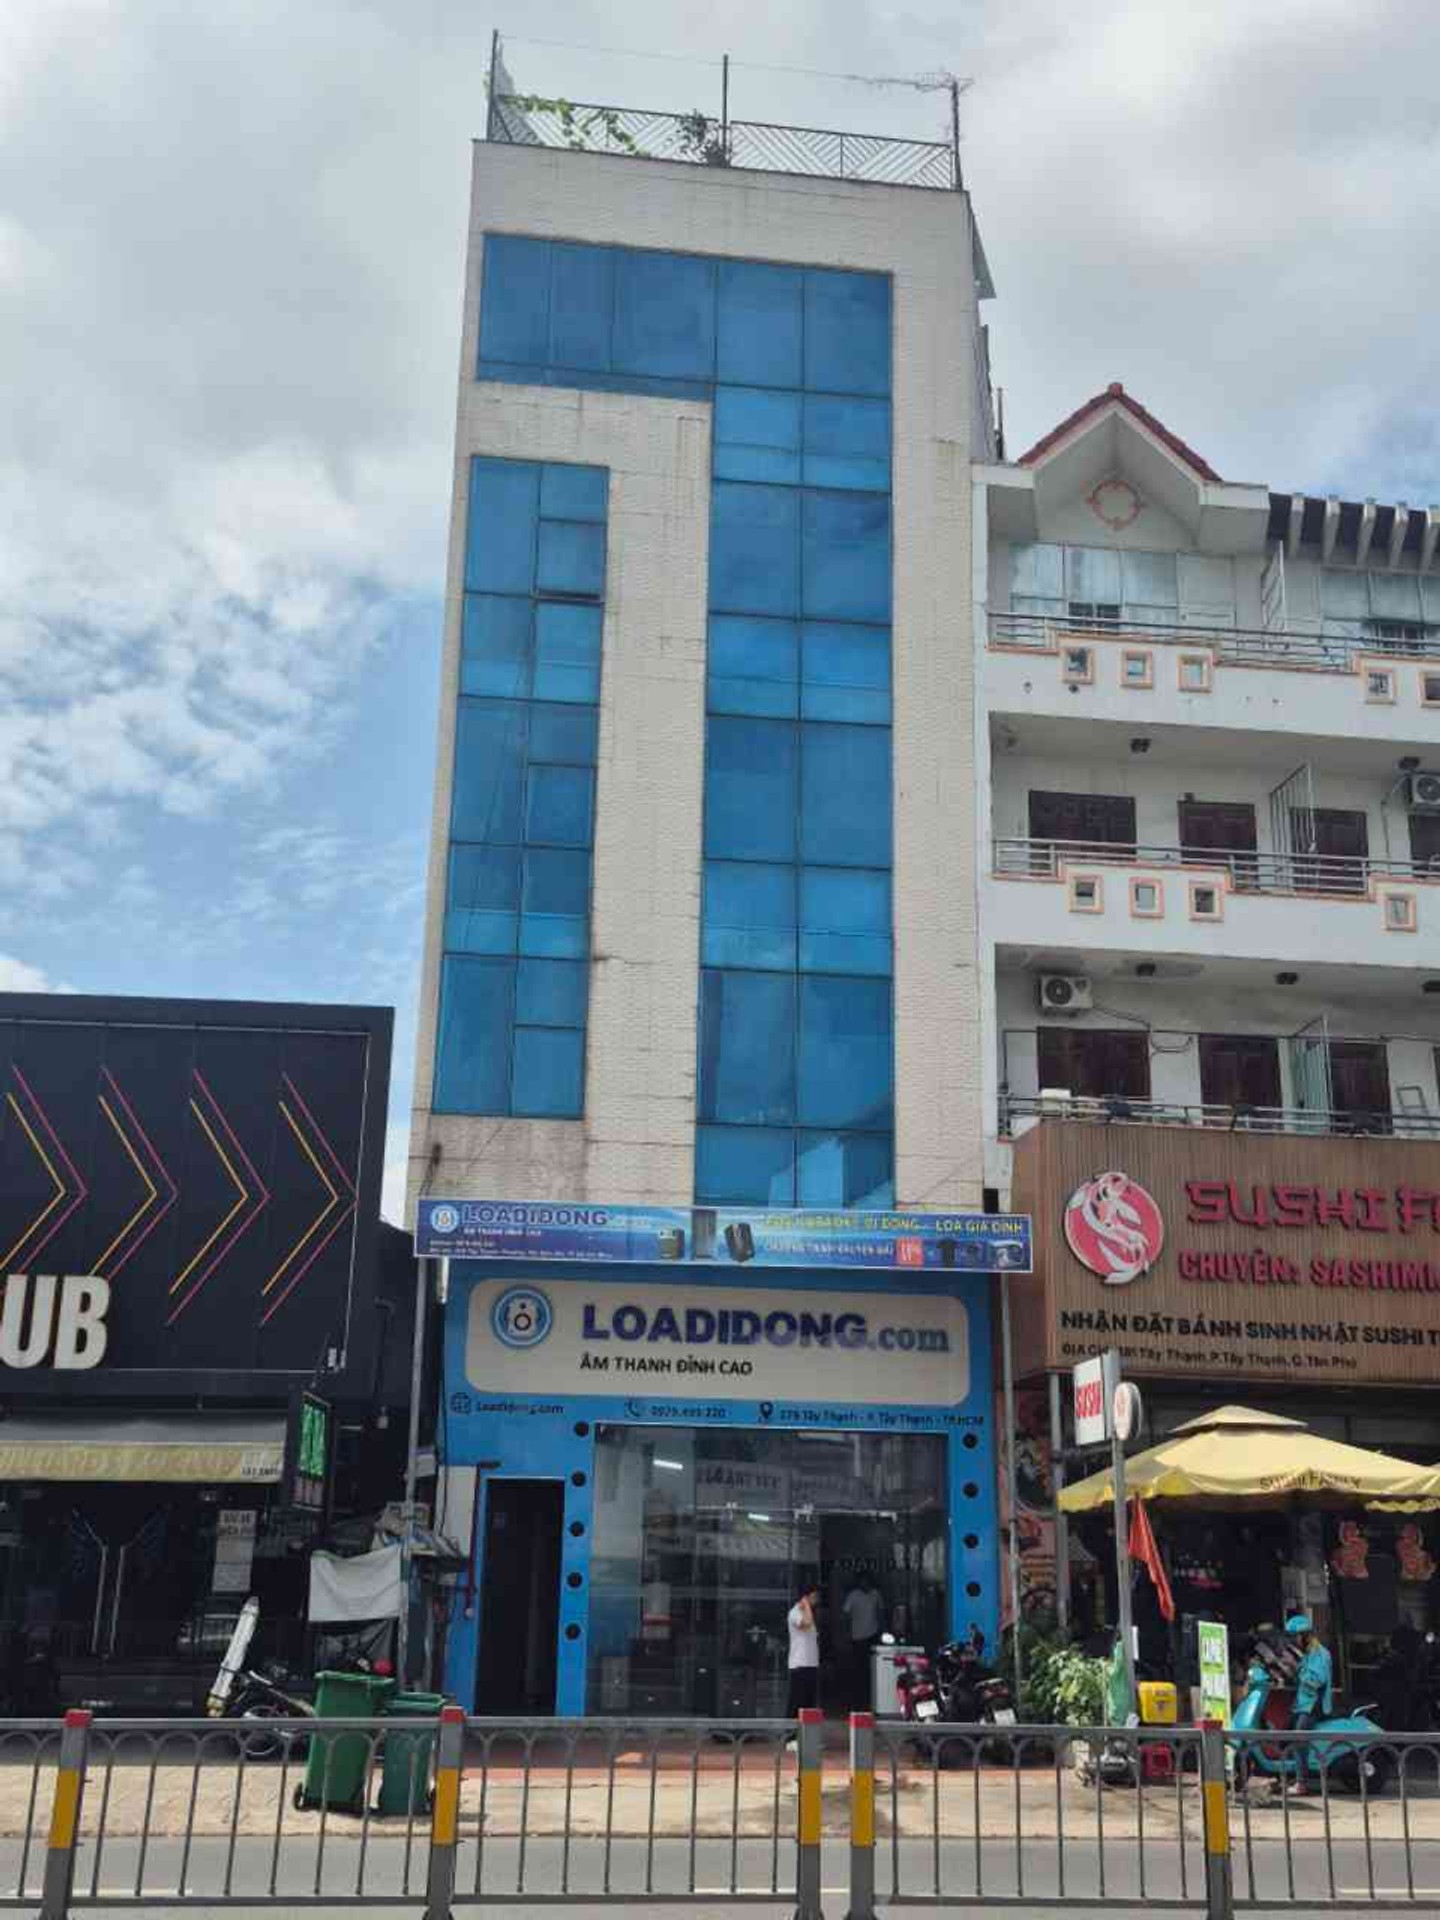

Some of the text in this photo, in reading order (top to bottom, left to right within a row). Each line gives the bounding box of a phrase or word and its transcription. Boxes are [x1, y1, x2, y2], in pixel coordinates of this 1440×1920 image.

[461, 1203, 608, 1226] LOADIDONG
[1185, 1177, 1440, 1235] SUSHI F
[581, 1303, 951, 1354] LOADIDONG.com
[1061, 1309, 1128, 1333] NHẬN
[1132, 1311, 1175, 1337] ĐẶT
[1177, 1311, 1242, 1338] BÁNH
[1245, 1322, 1297, 1342] SINH
[1300, 1321, 1358, 1346] NHẬT
[1362, 1326, 1424, 1345] SUSHI
[579, 1351, 611, 1374] ÂM
[614, 1357, 672, 1376] THANH
[719, 1362, 754, 1378] CAO
